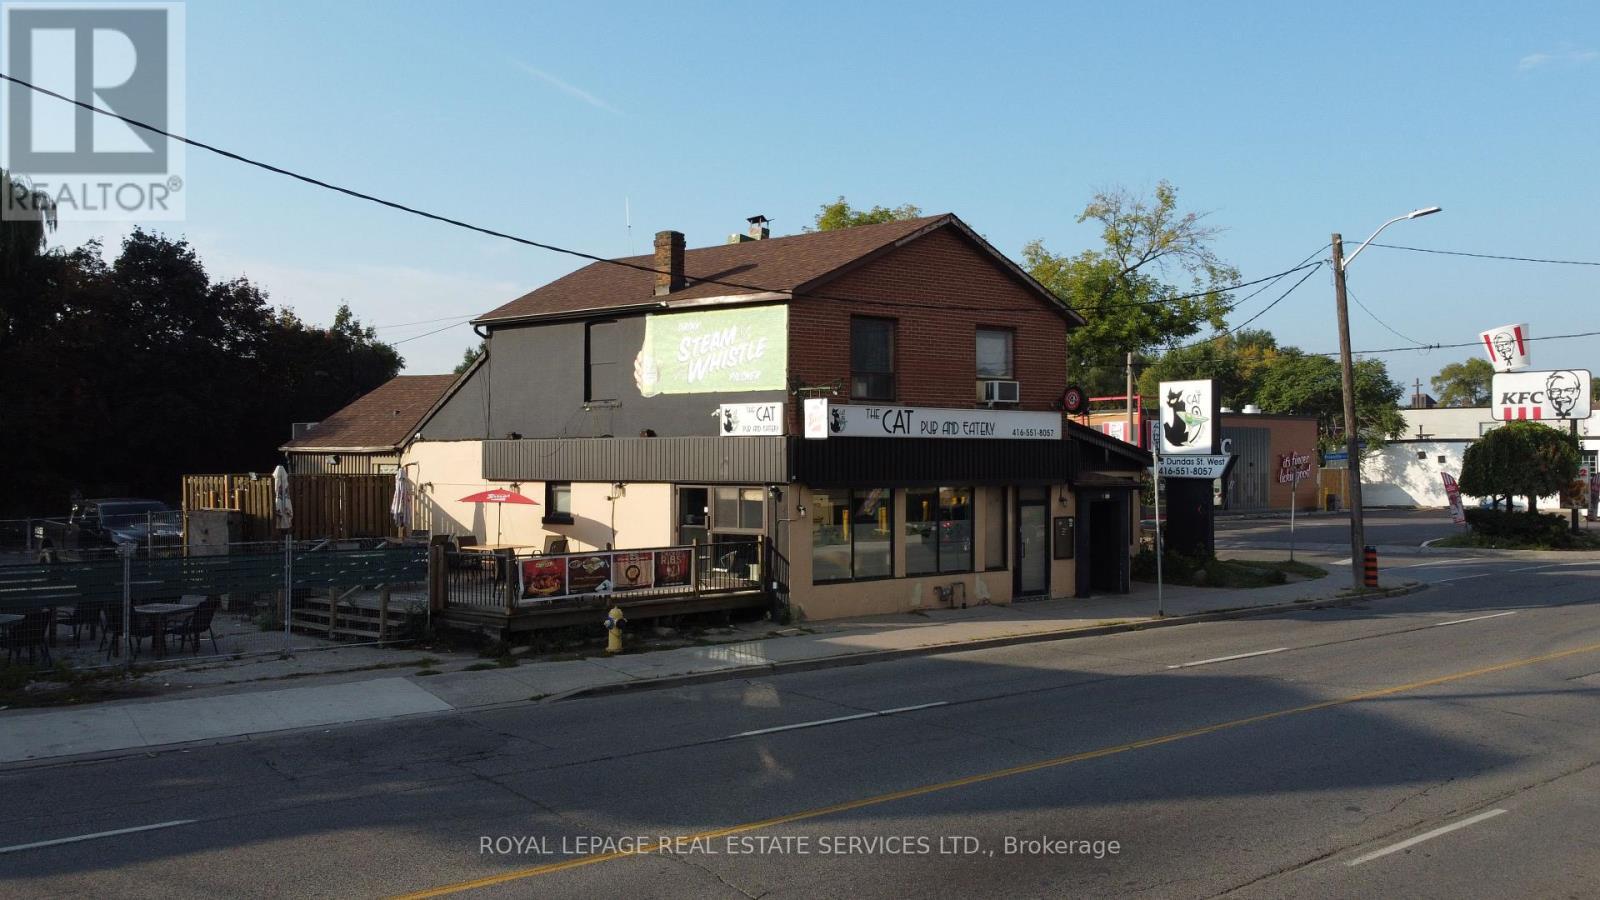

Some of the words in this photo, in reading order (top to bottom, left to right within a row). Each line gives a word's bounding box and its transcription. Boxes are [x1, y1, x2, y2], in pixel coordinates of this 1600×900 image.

[677, 324, 737, 362] STEAM
[687, 336, 769, 383] WHISTLE
[1186, 393, 1202, 405] CAT
[1501, 391, 1544, 404] KFC
[756, 405, 775, 421] CAT
[866, 408, 880, 420] THE
[882, 409, 914, 434] CAT
[920, 420, 938, 435] PUB
[942, 420, 959, 435] AND
[962, 421, 995, 436] EATERY
[1012, 429, 1054, 437] 416-551-8057
[1166, 457, 1195, 466] Dundas
[1196, 457, 1205, 466] St.
[1207, 457, 1225, 466] West
[1158, 467, 1213, 476] 416-551-8057
